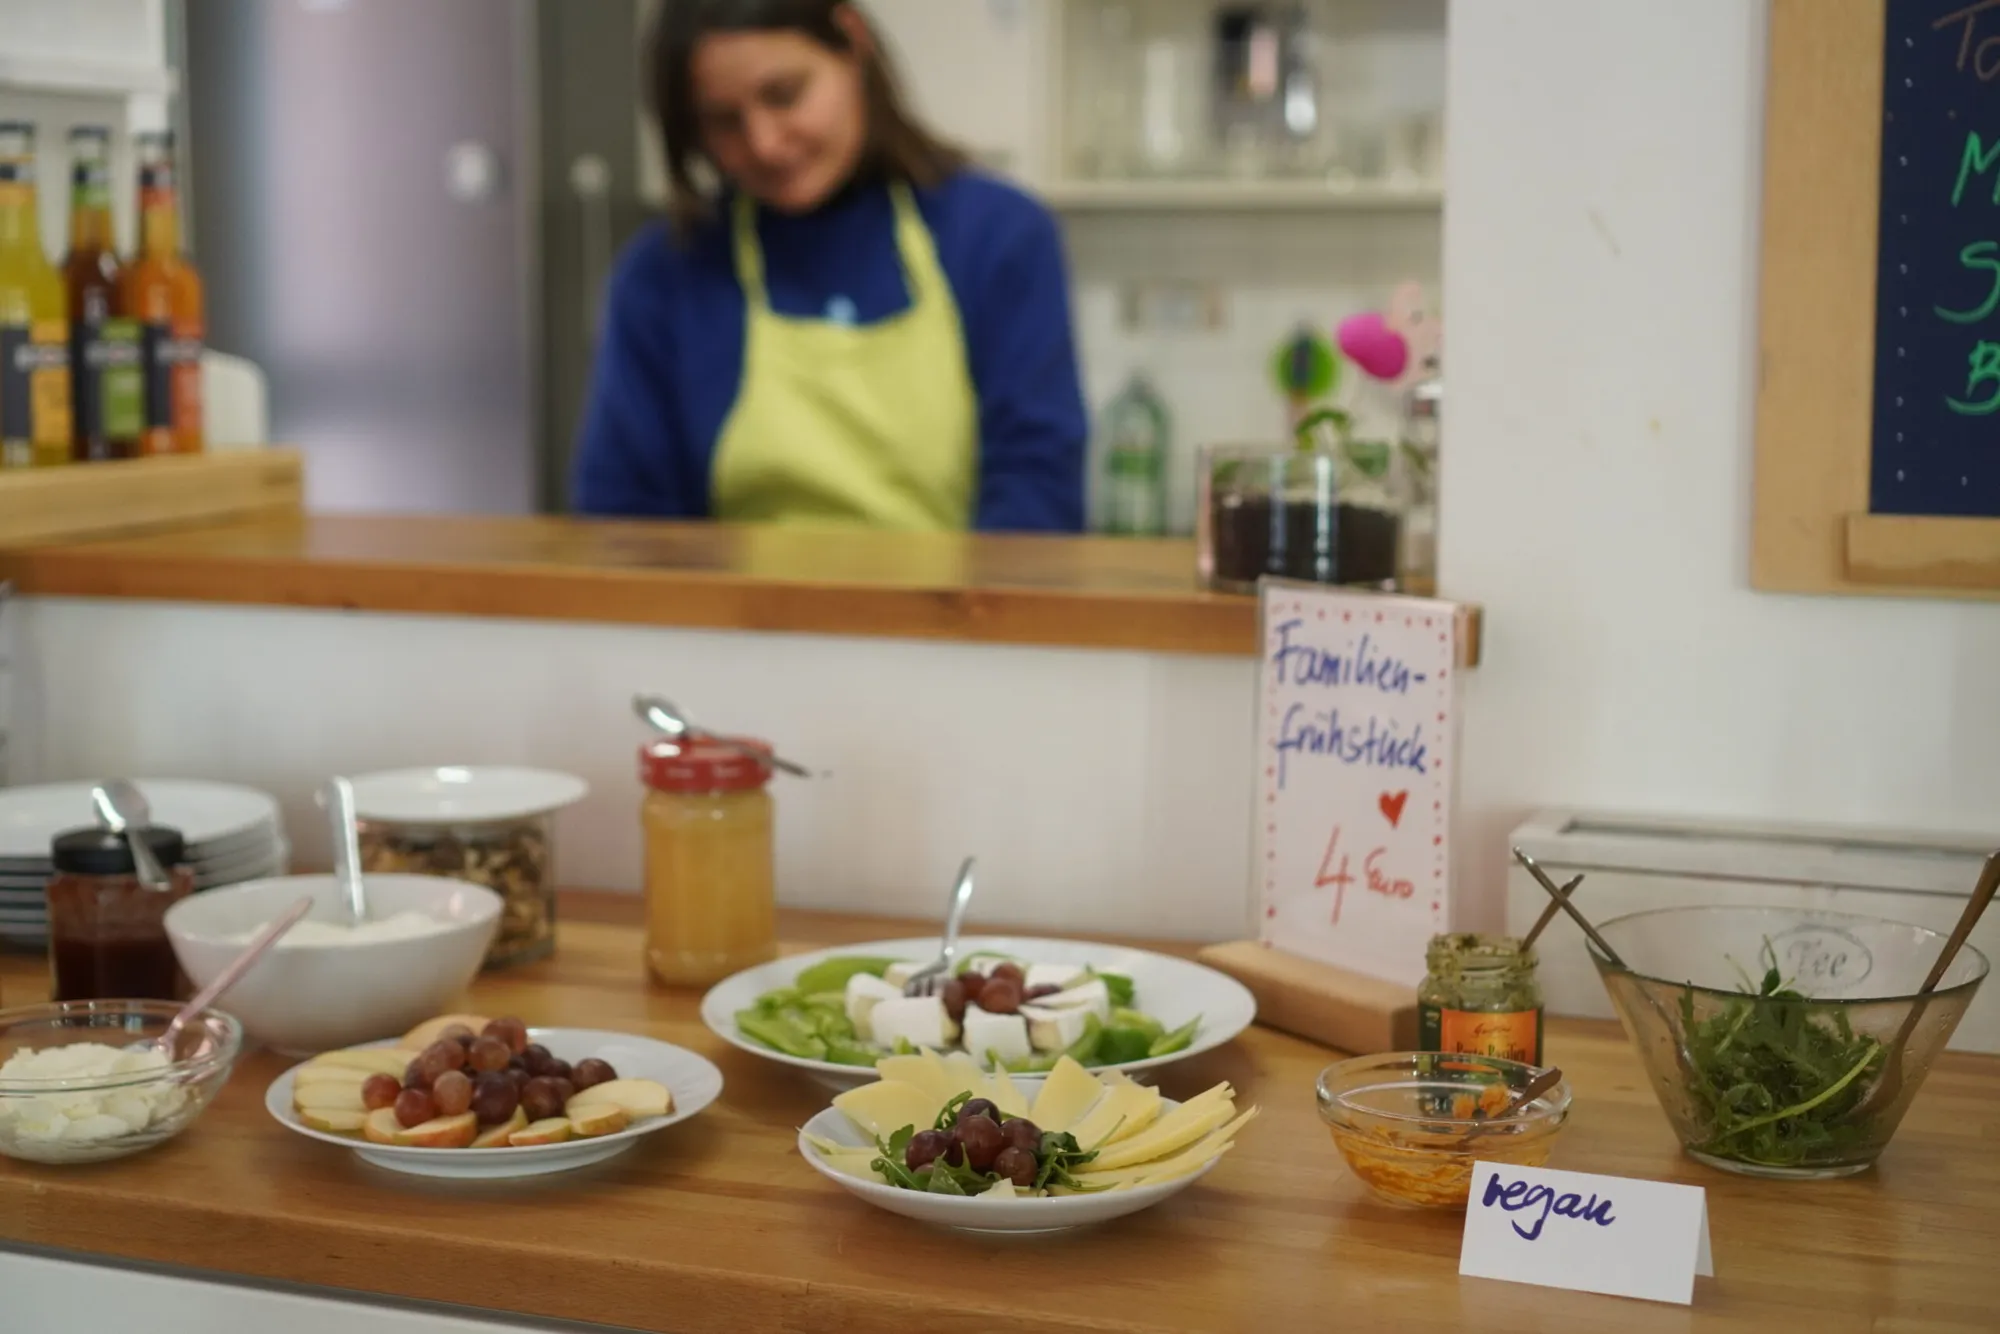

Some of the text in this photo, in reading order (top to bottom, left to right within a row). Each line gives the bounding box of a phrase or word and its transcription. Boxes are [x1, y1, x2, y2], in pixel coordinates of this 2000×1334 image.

[1274, 618, 1427, 694] Familien-
[1314, 825, 1414, 926] 4 Euro
[1482, 1173, 1616, 1241] vegan
